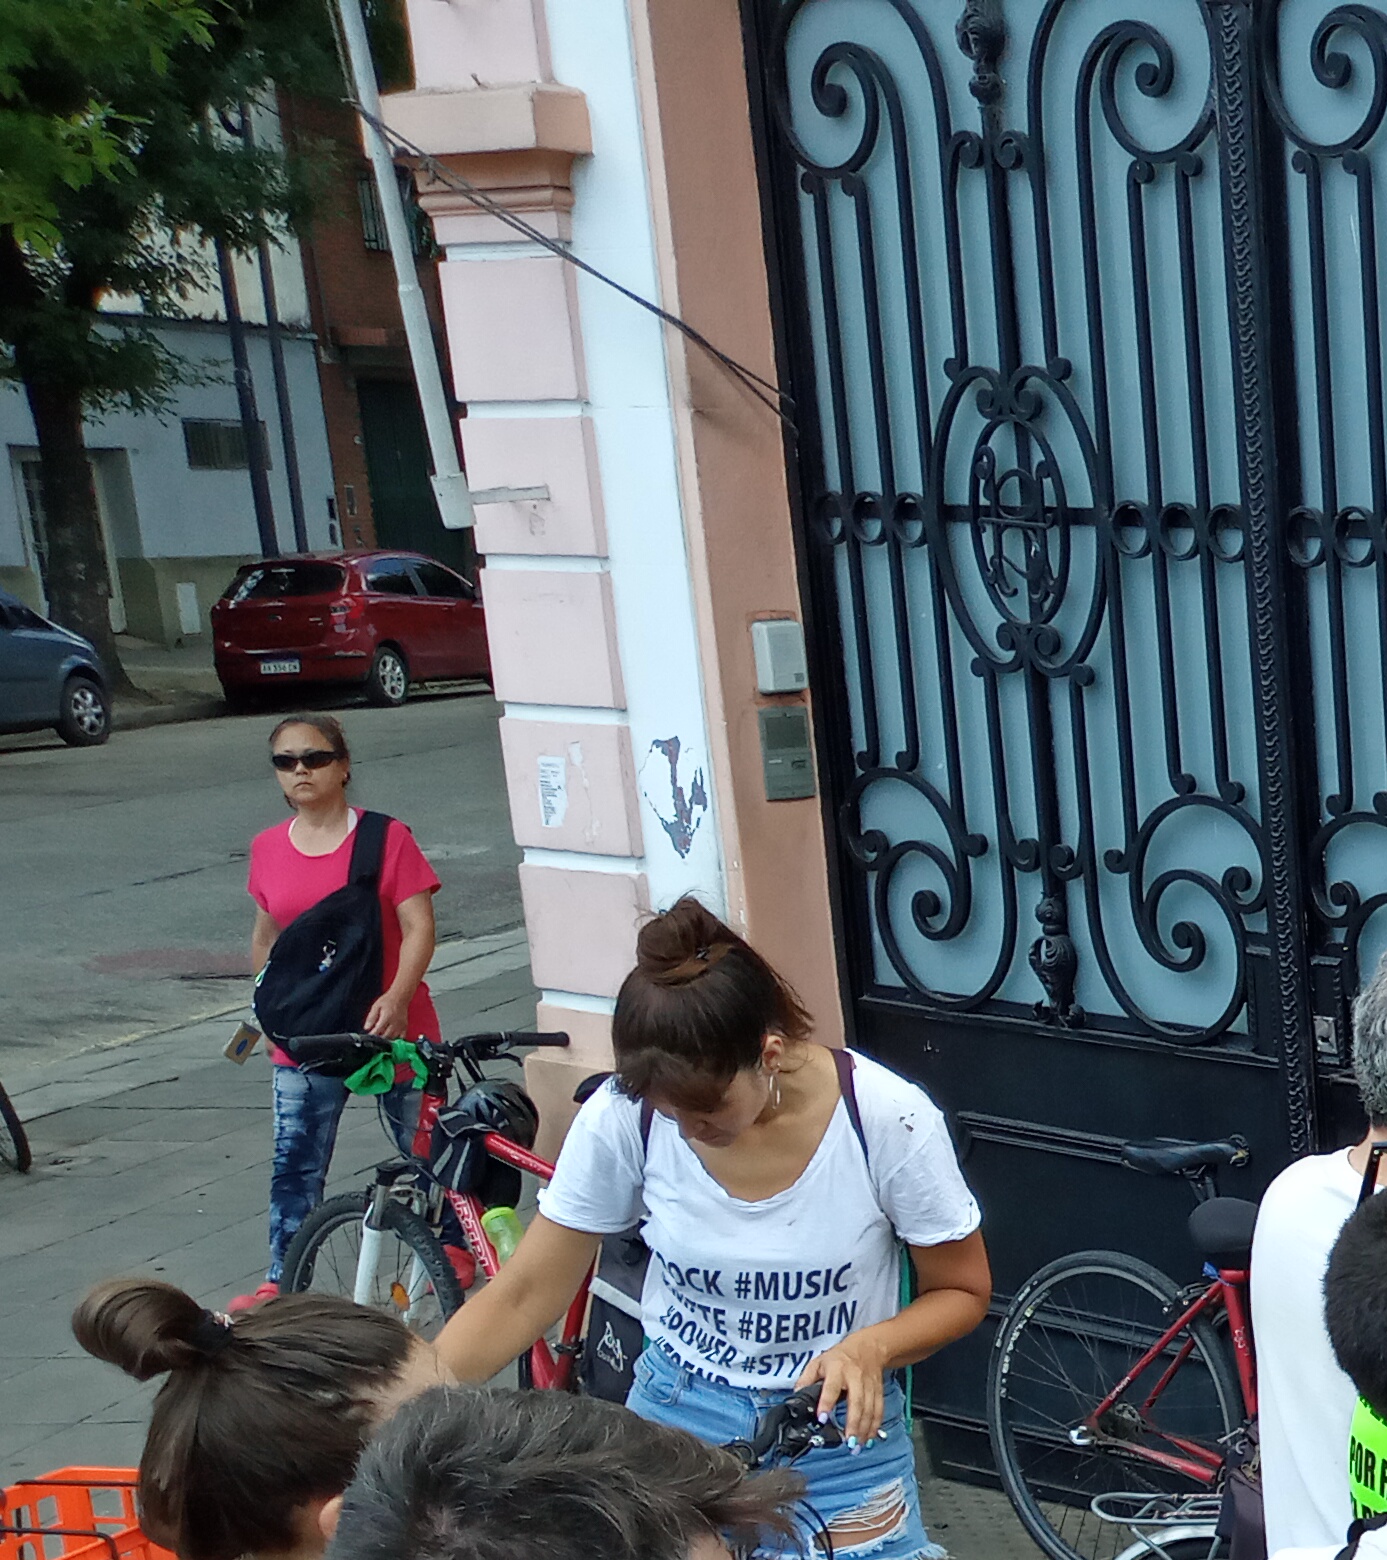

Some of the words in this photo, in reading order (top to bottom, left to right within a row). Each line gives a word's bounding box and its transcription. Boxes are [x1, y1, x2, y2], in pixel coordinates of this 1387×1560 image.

[734, 1262, 852, 1301] #MUSIC
[738, 1300, 857, 1344] #BERLIN
[741, 1350, 822, 1379] #STY
[1349, 1435, 1376, 1492] POR
